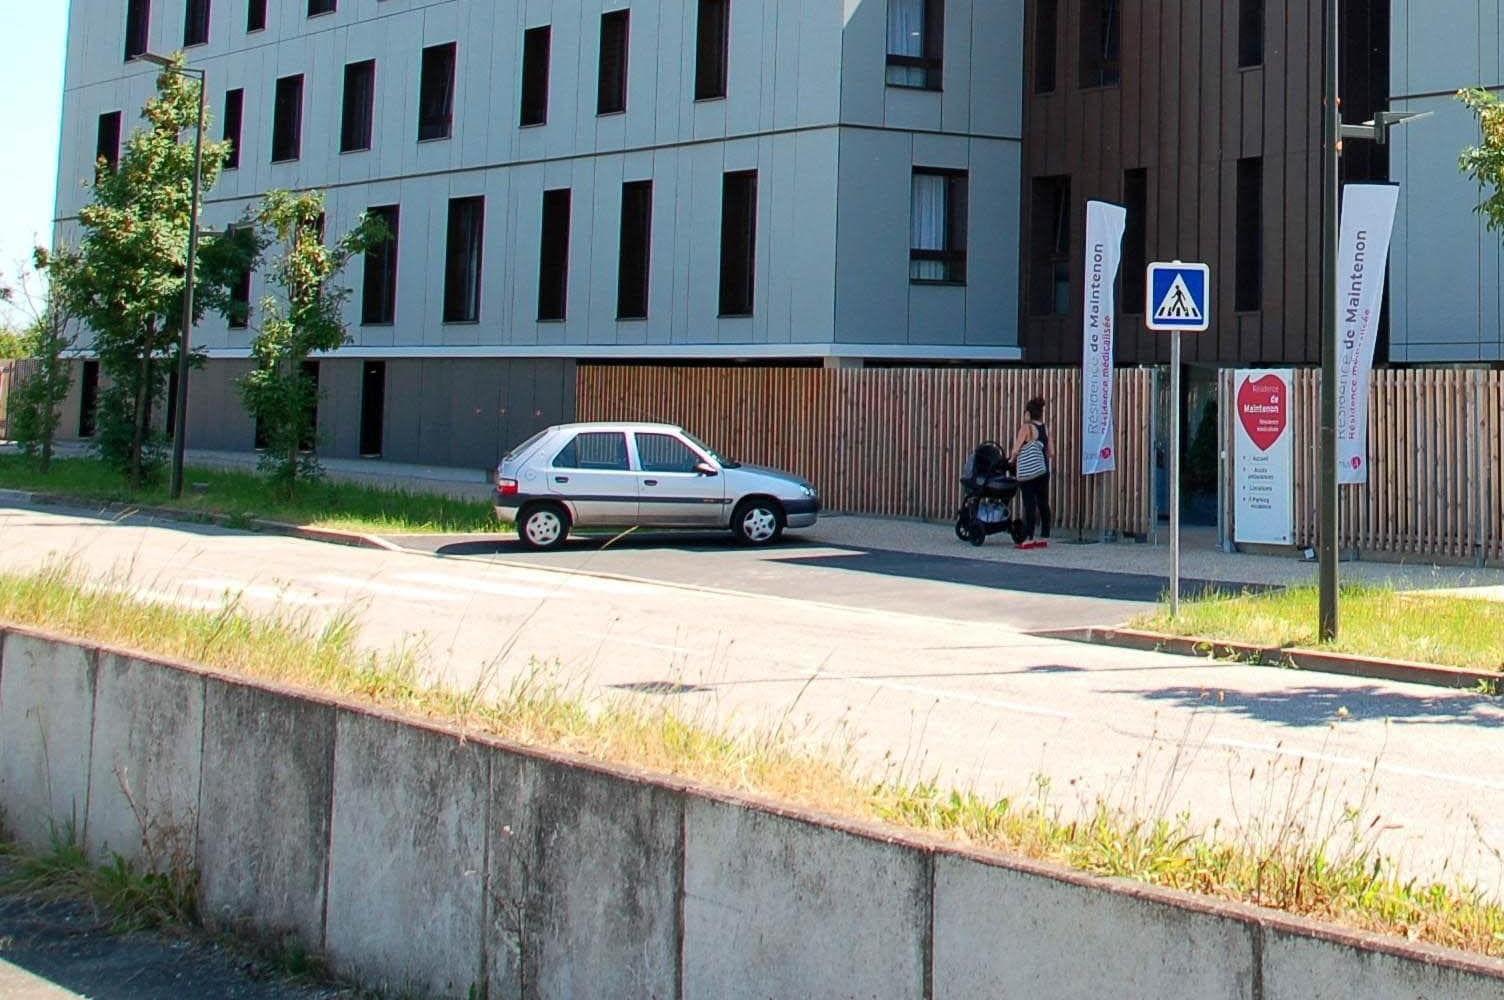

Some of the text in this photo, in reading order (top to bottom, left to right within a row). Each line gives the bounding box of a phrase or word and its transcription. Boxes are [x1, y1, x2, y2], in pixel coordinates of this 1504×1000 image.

[1089, 243, 1104, 329] Maintenon
[1345, 230, 1368, 323] Maintenon
[1090, 334, 1099, 353] de
[1343, 329, 1356, 350] de
